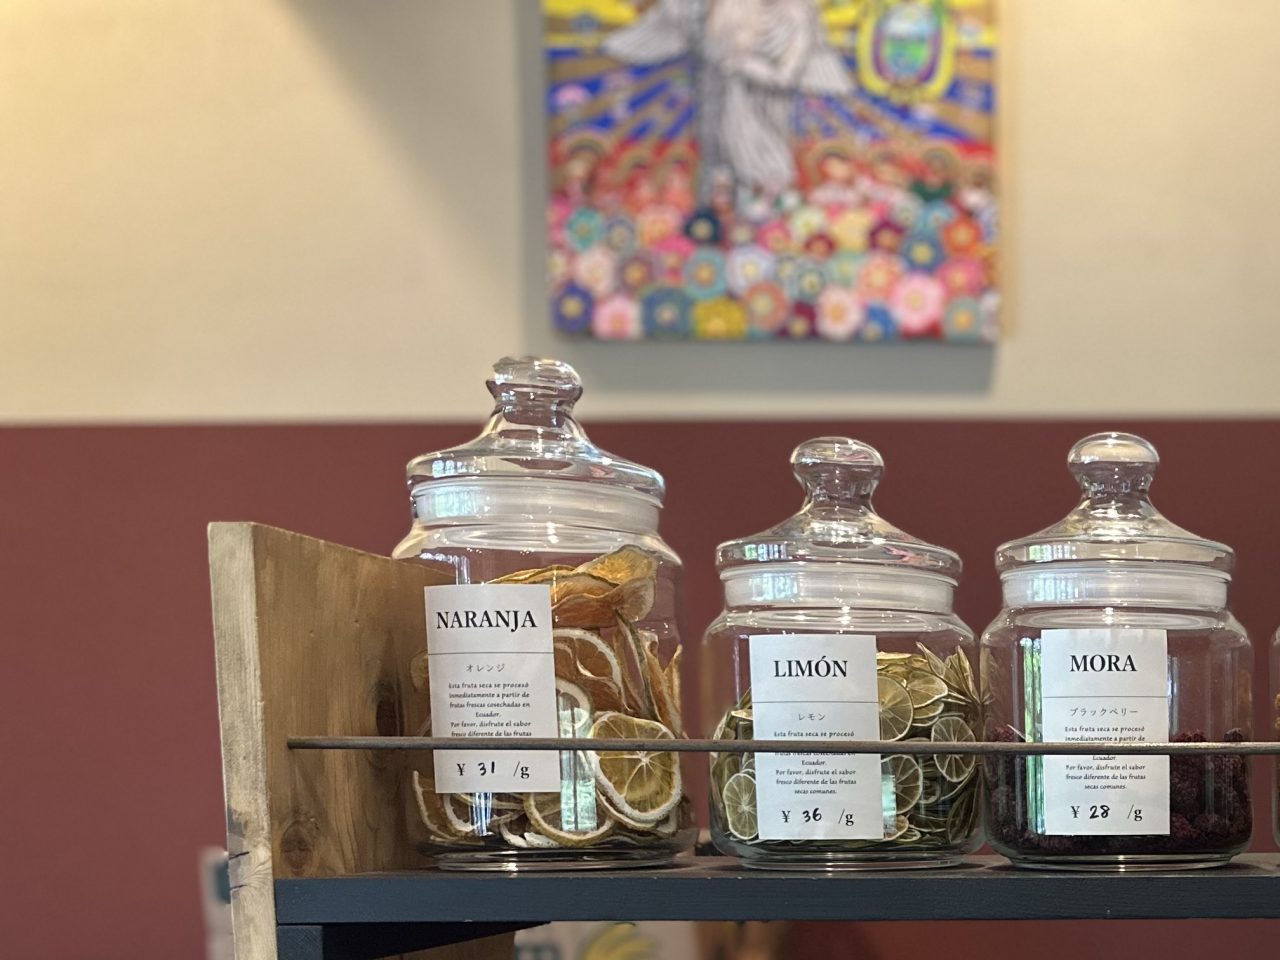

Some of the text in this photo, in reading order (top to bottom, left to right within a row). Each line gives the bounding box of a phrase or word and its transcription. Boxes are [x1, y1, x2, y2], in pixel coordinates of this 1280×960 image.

[436, 611, 537, 632] NARANJA
[466, 664, 505, 672] オレンジ
[774, 656, 848, 677] LIMÓN
[1071, 655, 1137, 672] MORA
[478, 761, 495, 776] 31
[803, 808, 822, 822] 36
[1090, 805, 1110, 819] 28
